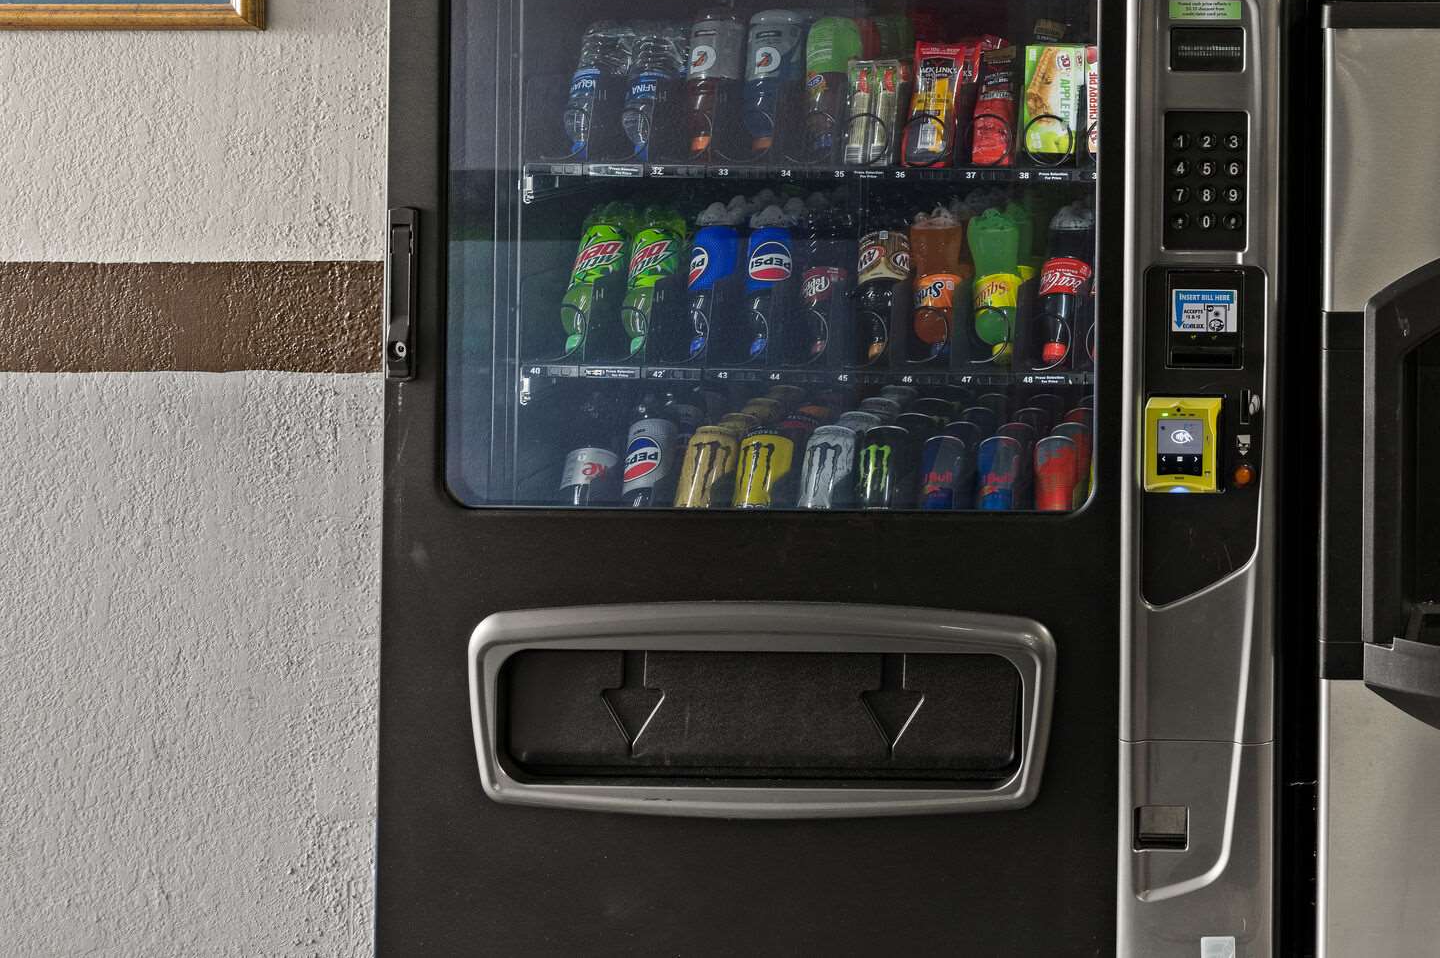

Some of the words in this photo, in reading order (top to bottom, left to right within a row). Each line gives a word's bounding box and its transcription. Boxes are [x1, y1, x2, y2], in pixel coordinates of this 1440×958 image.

[1060, 79, 1071, 110] APPLE
[1177, 135, 1183, 148] 1
[1202, 135, 1211, 148] 2
[1229, 135, 1238, 148] 3
[1176, 162, 1185, 174] 4
[1202, 162, 1211, 175] 5
[1229, 162, 1238, 175] 6
[1176, 189, 1184, 201] 7
[1202, 189, 1211, 202] 8
[1229, 189, 1238, 202] 9
[1202, 215, 1210, 228] 0
[750, 258, 792, 270] PEPSI
[529, 367, 541, 375] 40
[1023, 376, 1033, 384] 48
